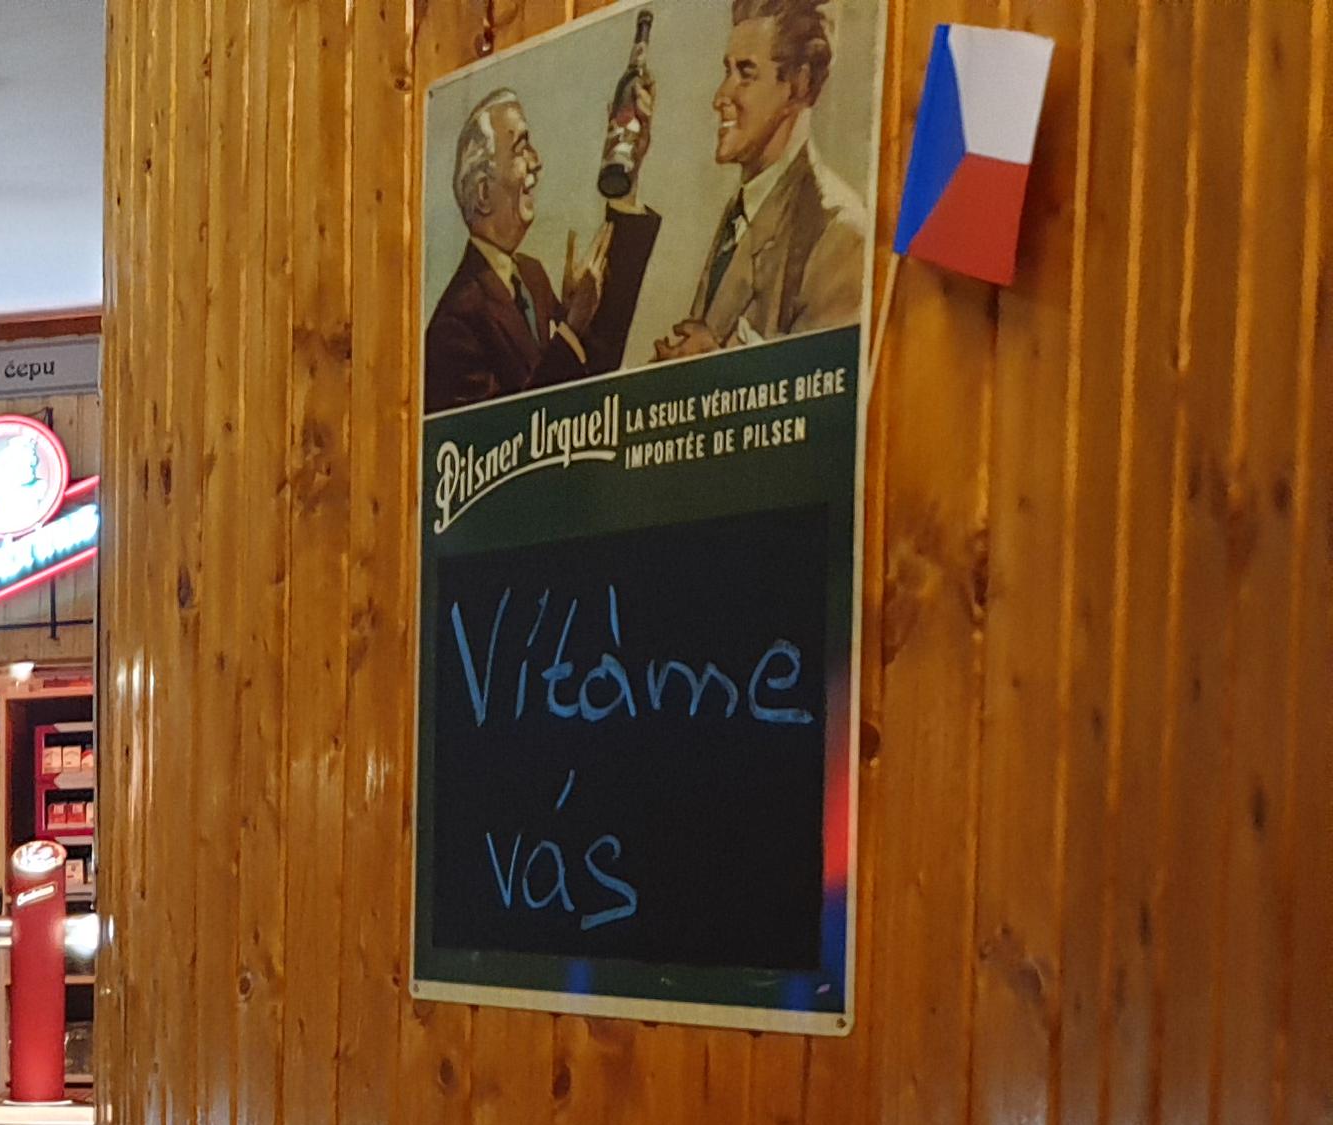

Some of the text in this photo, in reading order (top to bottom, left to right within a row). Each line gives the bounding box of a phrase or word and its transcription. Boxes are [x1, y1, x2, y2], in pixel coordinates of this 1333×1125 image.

[625, 407, 645, 433] LA
[648, 396, 697, 429] SEULE
[700, 377, 790, 420] VÉRITABLE
[434, 393, 620, 535] Pilsner Urquell
[624, 415, 807, 470] IMPORTÉE DE PILSEN
